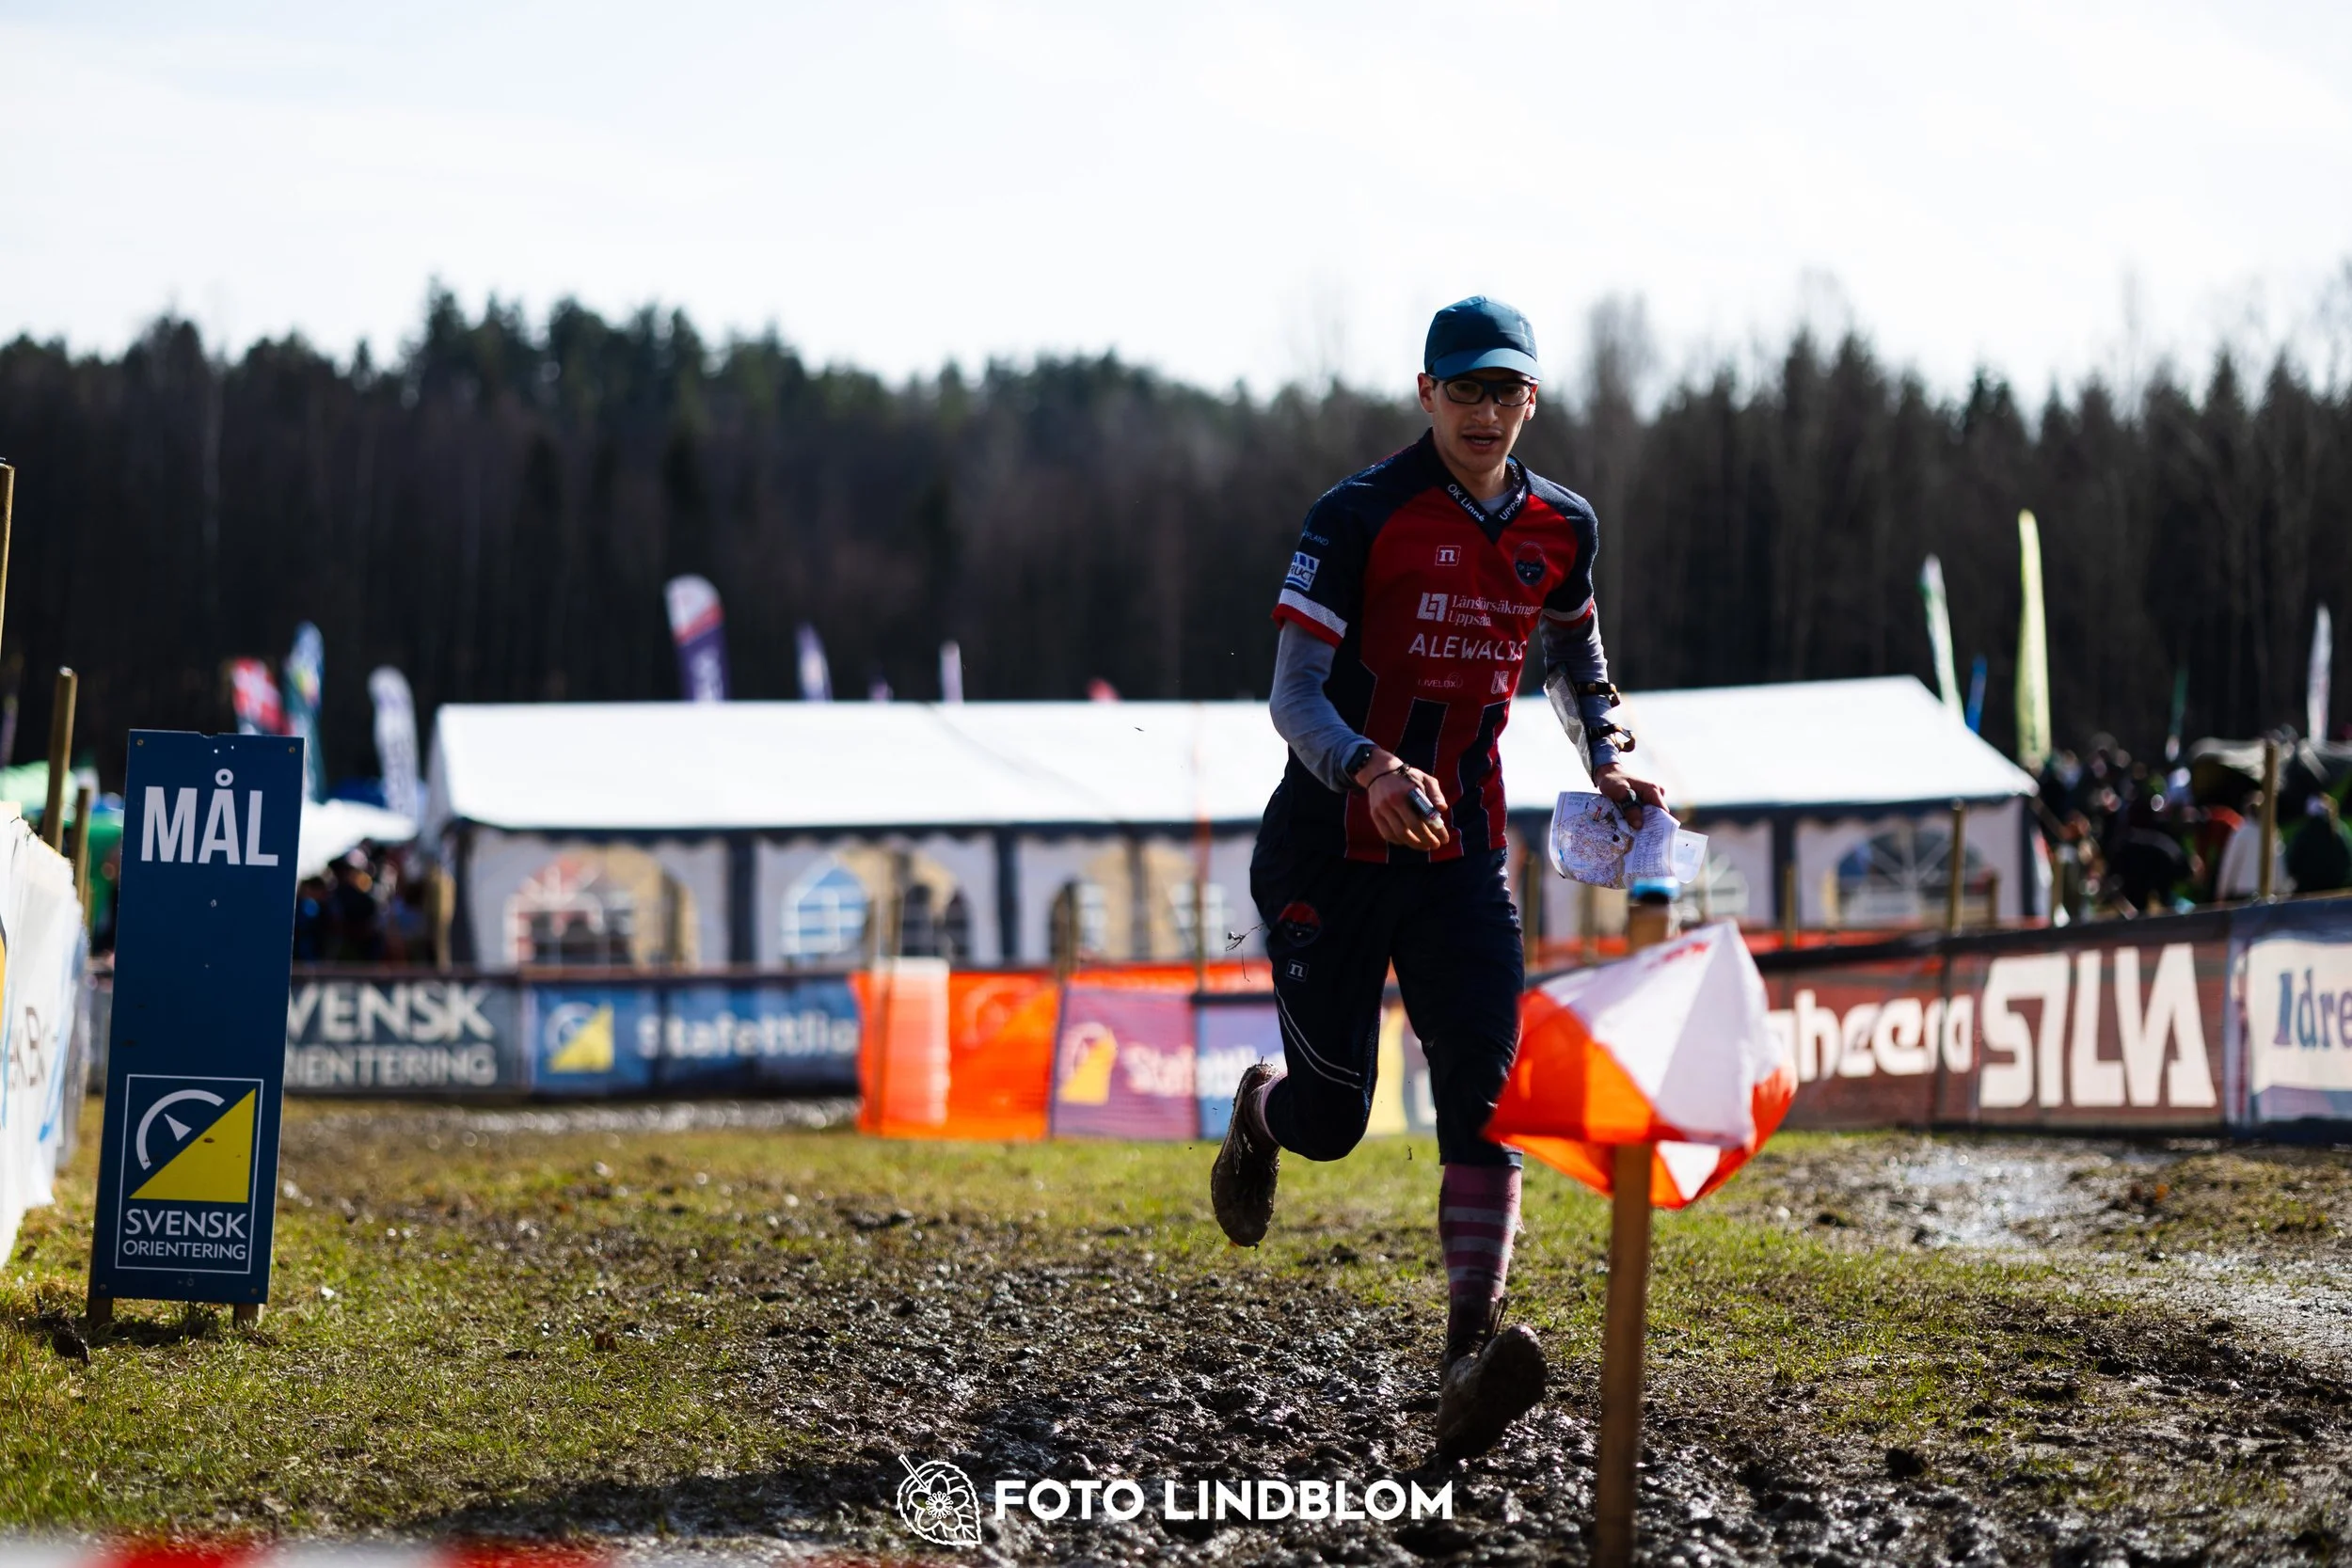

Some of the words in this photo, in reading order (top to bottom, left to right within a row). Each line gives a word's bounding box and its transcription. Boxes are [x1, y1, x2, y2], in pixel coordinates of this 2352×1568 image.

[1447, 483, 1463, 500] OK
[1460, 497, 1486, 523] Linné
[141, 768, 279, 866] MÅL
[1979, 942, 2217, 1109] SILVA
[125, 1208, 247, 1239] SVENSK
[122, 1240, 246, 1260] ORIENTERING
